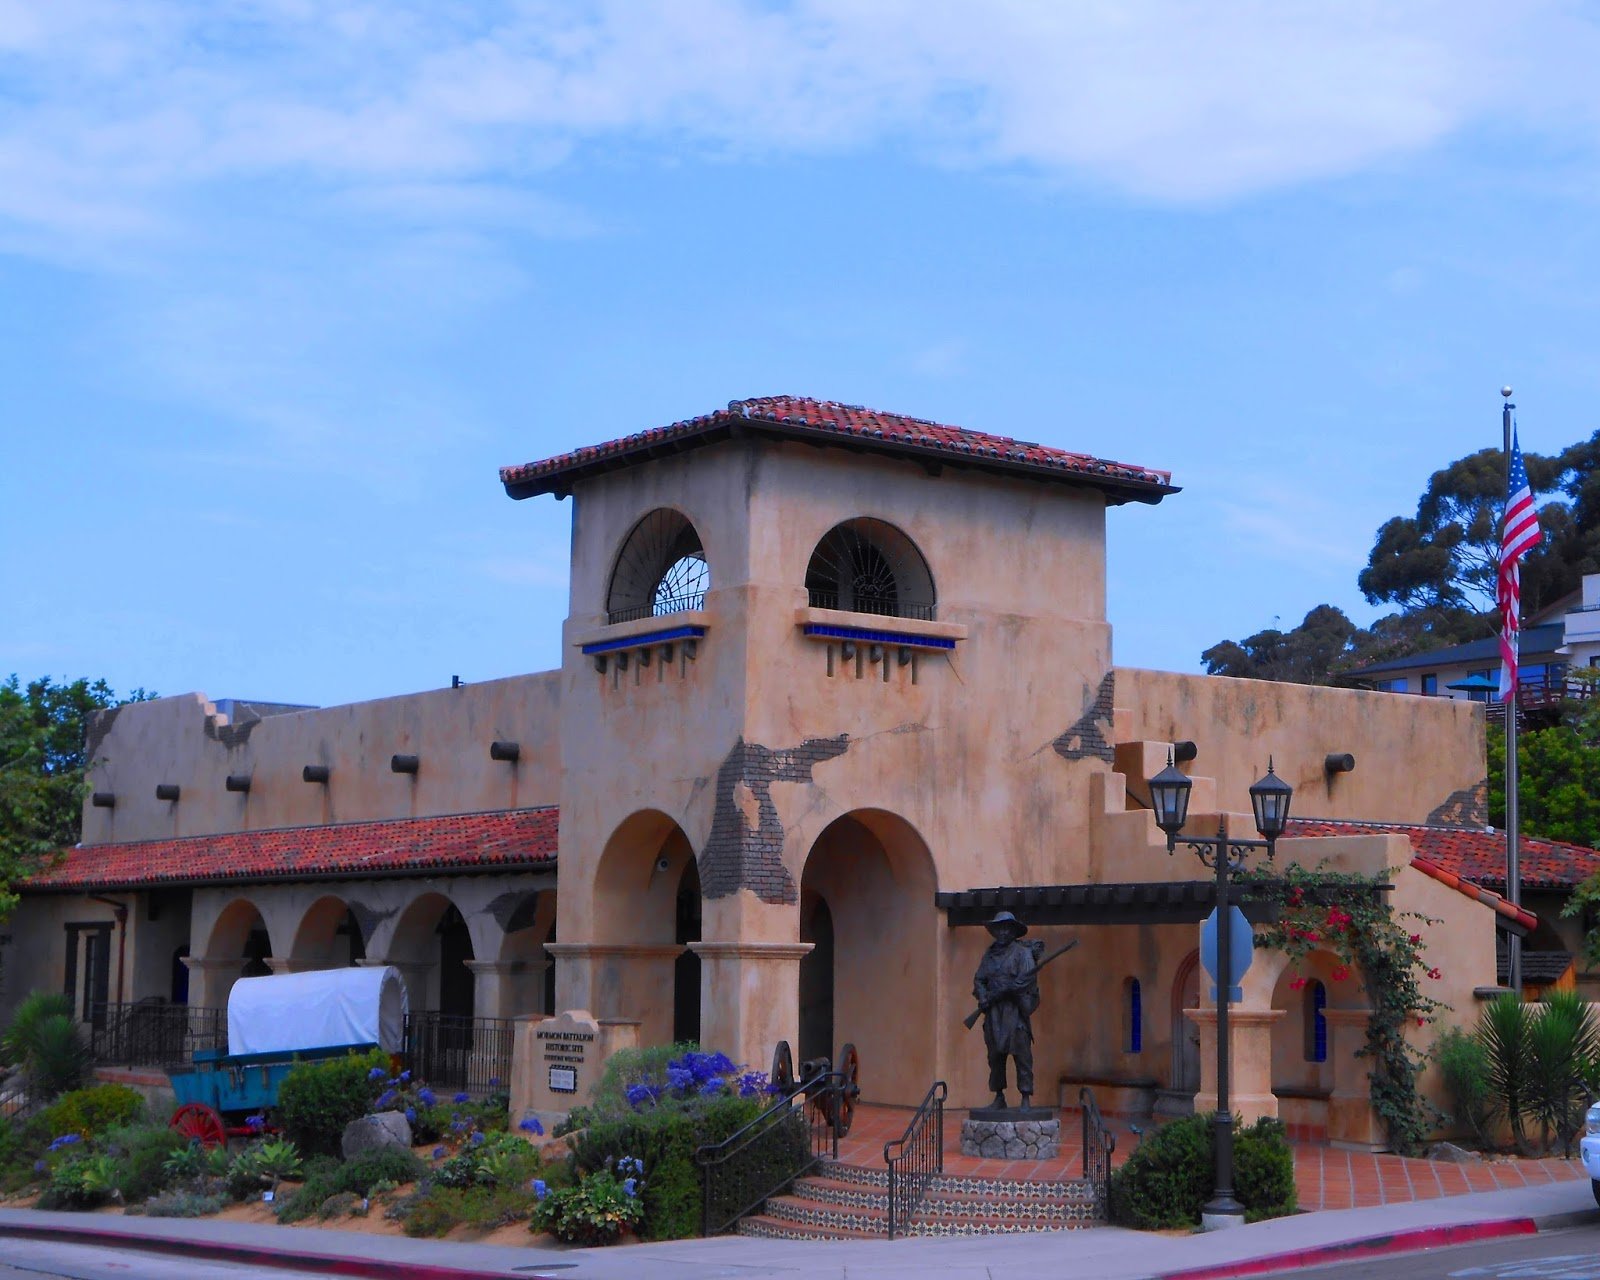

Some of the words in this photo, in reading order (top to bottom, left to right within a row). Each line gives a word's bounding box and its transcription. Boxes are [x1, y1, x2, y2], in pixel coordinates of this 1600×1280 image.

[537, 1031, 562, 1040] MORMON
[563, 1032, 594, 1042] BATTALION
[545, 1043, 571, 1052] HISTORIC
[571, 1044, 584, 1053] SITE
